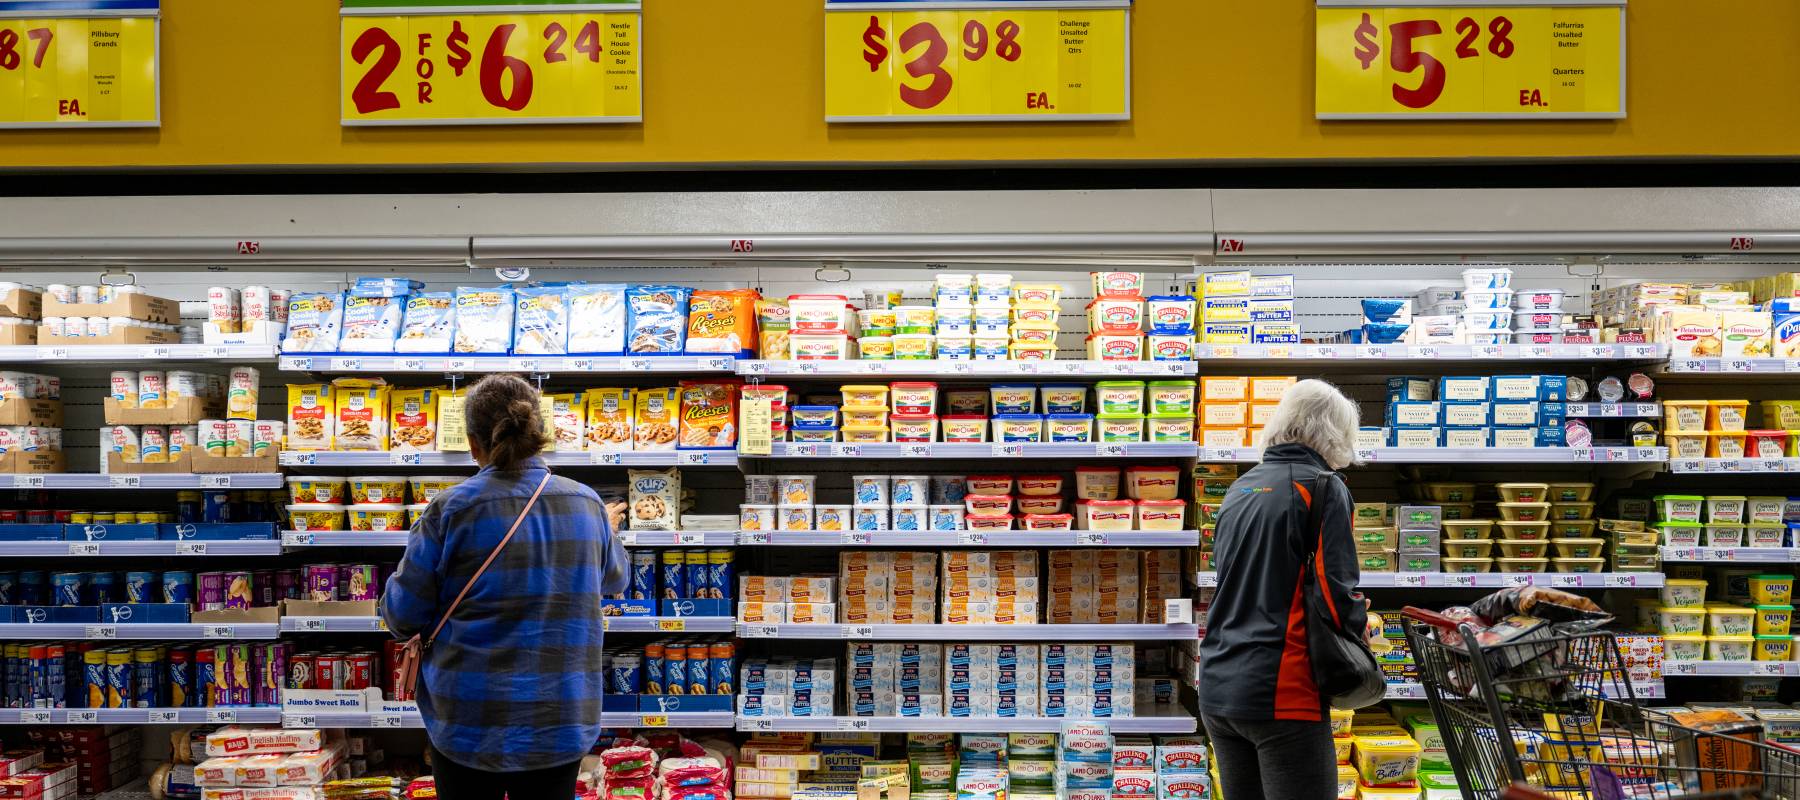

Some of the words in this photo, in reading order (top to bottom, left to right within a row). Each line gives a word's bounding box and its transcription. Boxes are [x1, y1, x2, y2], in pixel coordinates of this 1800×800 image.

[1059, 20, 1090, 28] Challenge
[91, 31, 120, 39] Pillsbury
[1558, 40, 1579, 48] Butter
[351, 27, 401, 113] 2
[1552, 68, 1584, 76] Quarters
[1026, 92, 1055, 109] EA.
[1519, 89, 1548, 107] EA.
[59, 99, 86, 116] EA.
[238, 241, 260, 254] A5
[731, 240, 753, 252] A6
[1222, 239, 1244, 252] A7
[1731, 237, 1753, 250] A8
[691, 314, 736, 331] Reese's
[1766, 584, 1789, 592] OLIVIO
[1674, 596, 1697, 607] Vegan
[1764, 613, 1788, 621] OLIVIO
[1674, 624, 1696, 634] Vegan
[1724, 624, 1747, 635] Vegan
[1765, 643, 1788, 651] OLIVIO
[1675, 651, 1697, 660] Vegan
[1723, 652, 1745, 661] Vegan
[287, 698, 313, 706] Jumbo
[315, 698, 338, 706] Sweet
[340, 698, 359, 706] Rolls
[250, 735, 274, 745] English
[275, 734, 301, 743] Muffins
[1114, 750, 1147, 761] CHALLENGE
[1166, 751, 1200, 762] CHALLENGE
[1376, 764, 1407, 780] Butter!
[1116, 777, 1149, 788] CHALLENGE
[1170, 782, 1203, 792] CHALLENGE
